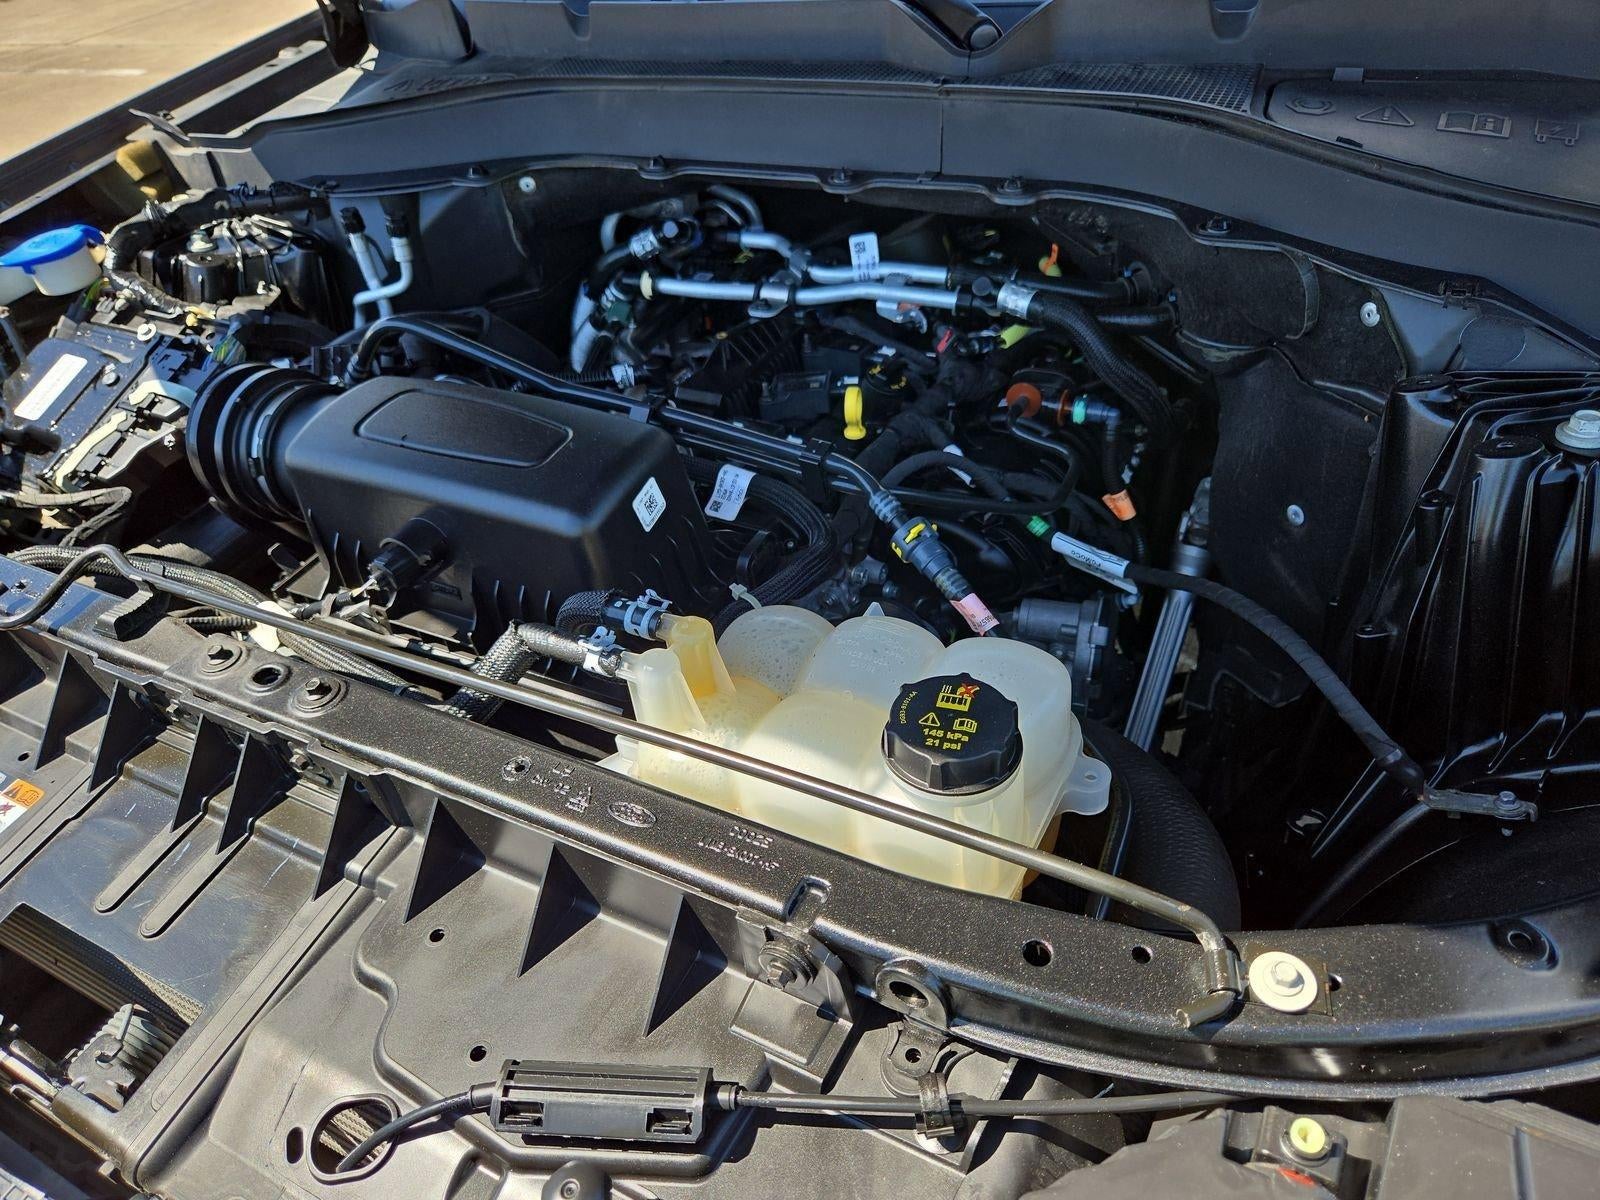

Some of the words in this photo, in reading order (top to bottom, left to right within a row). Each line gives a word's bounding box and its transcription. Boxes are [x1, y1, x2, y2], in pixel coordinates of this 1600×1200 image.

[923, 728, 944, 737] 145
[946, 731, 969, 742] kPa
[925, 738, 940, 746] 21
[942, 742, 962, 750] psi
